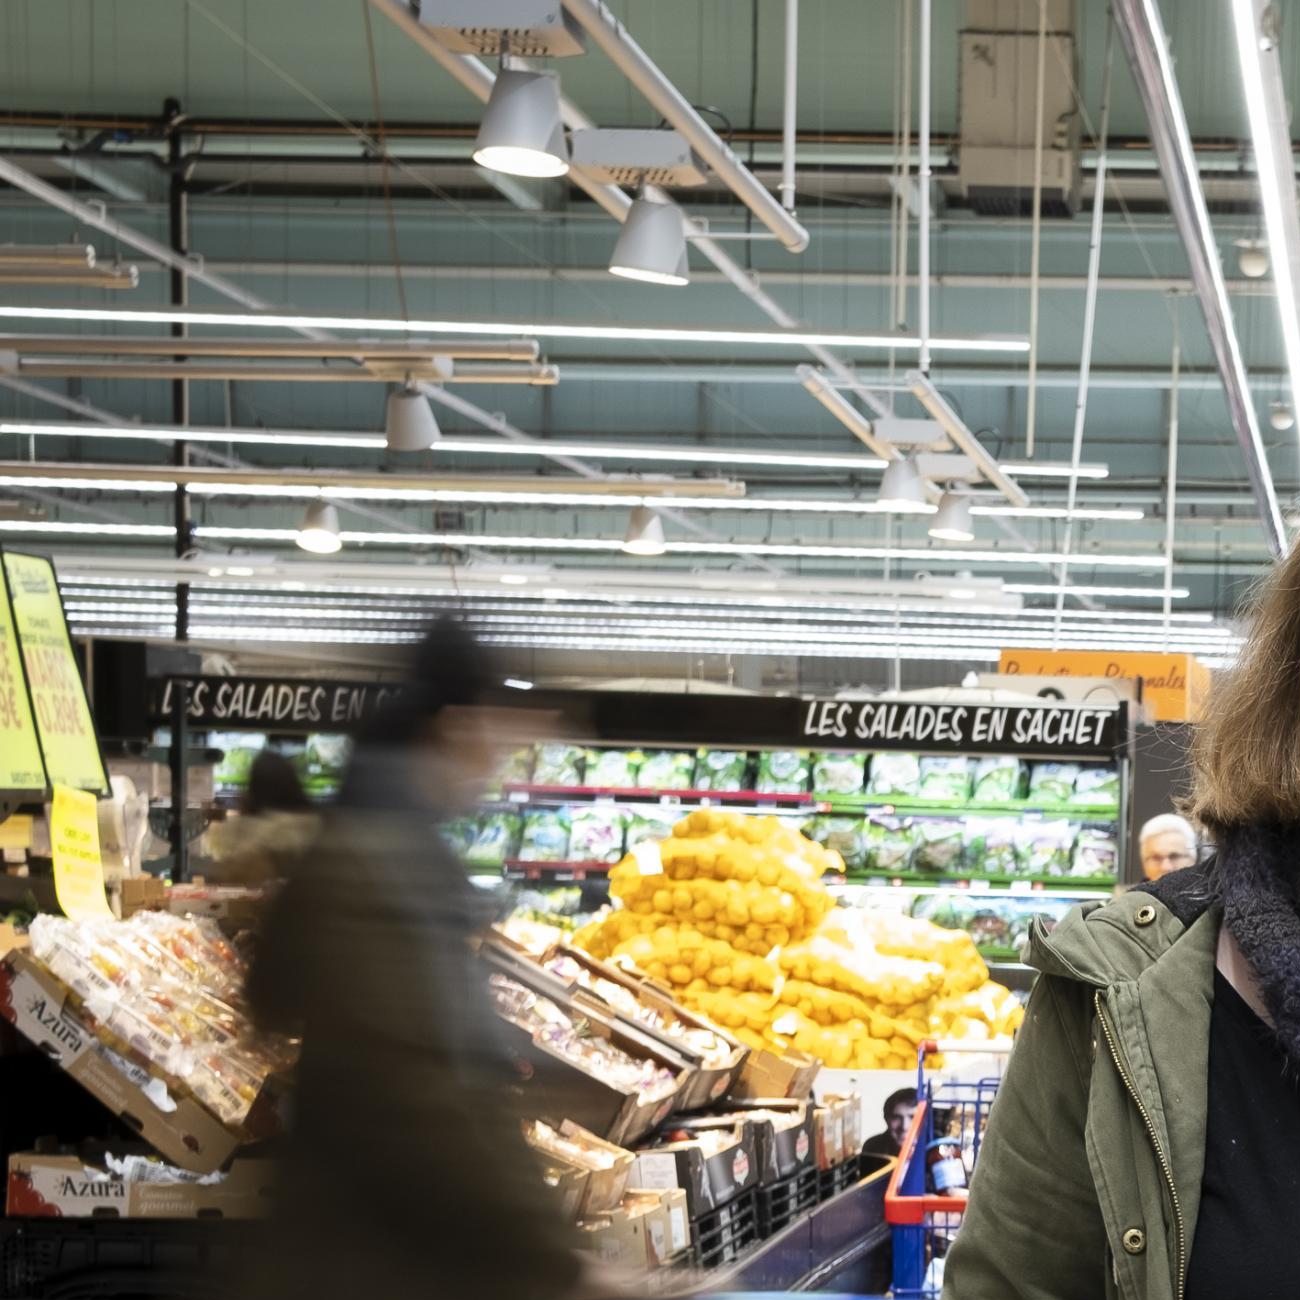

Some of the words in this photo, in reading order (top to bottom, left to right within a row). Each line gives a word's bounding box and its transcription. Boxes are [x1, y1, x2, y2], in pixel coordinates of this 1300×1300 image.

[212, 682, 327, 721] SALADES
[331, 687, 367, 720] EN
[804, 701, 852, 738] LES
[855, 703, 968, 742] SALADES
[972, 706, 1009, 742] EN
[1012, 707, 1113, 746] SACHET
[31, 998, 83, 1053] Azura
[62, 1176, 125, 1197] Azura
